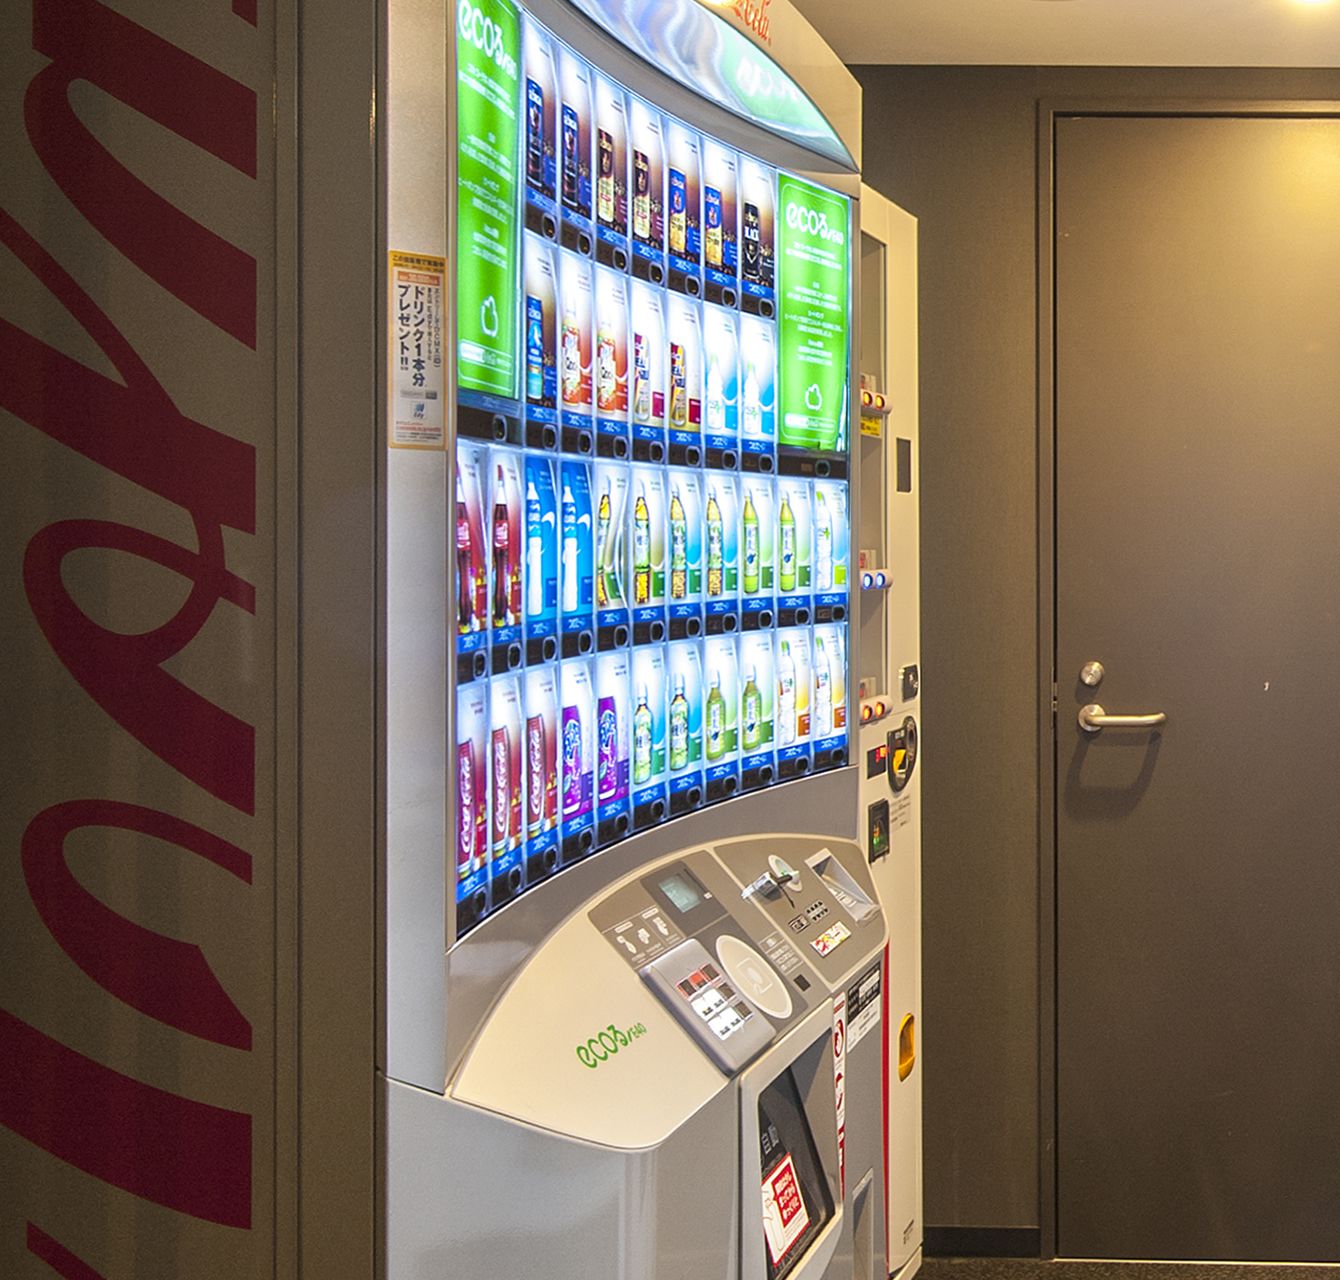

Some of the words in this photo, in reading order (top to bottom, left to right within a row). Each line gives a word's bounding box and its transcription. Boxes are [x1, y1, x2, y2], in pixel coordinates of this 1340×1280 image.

[412, 285, 425, 388] ドリンク1本分
